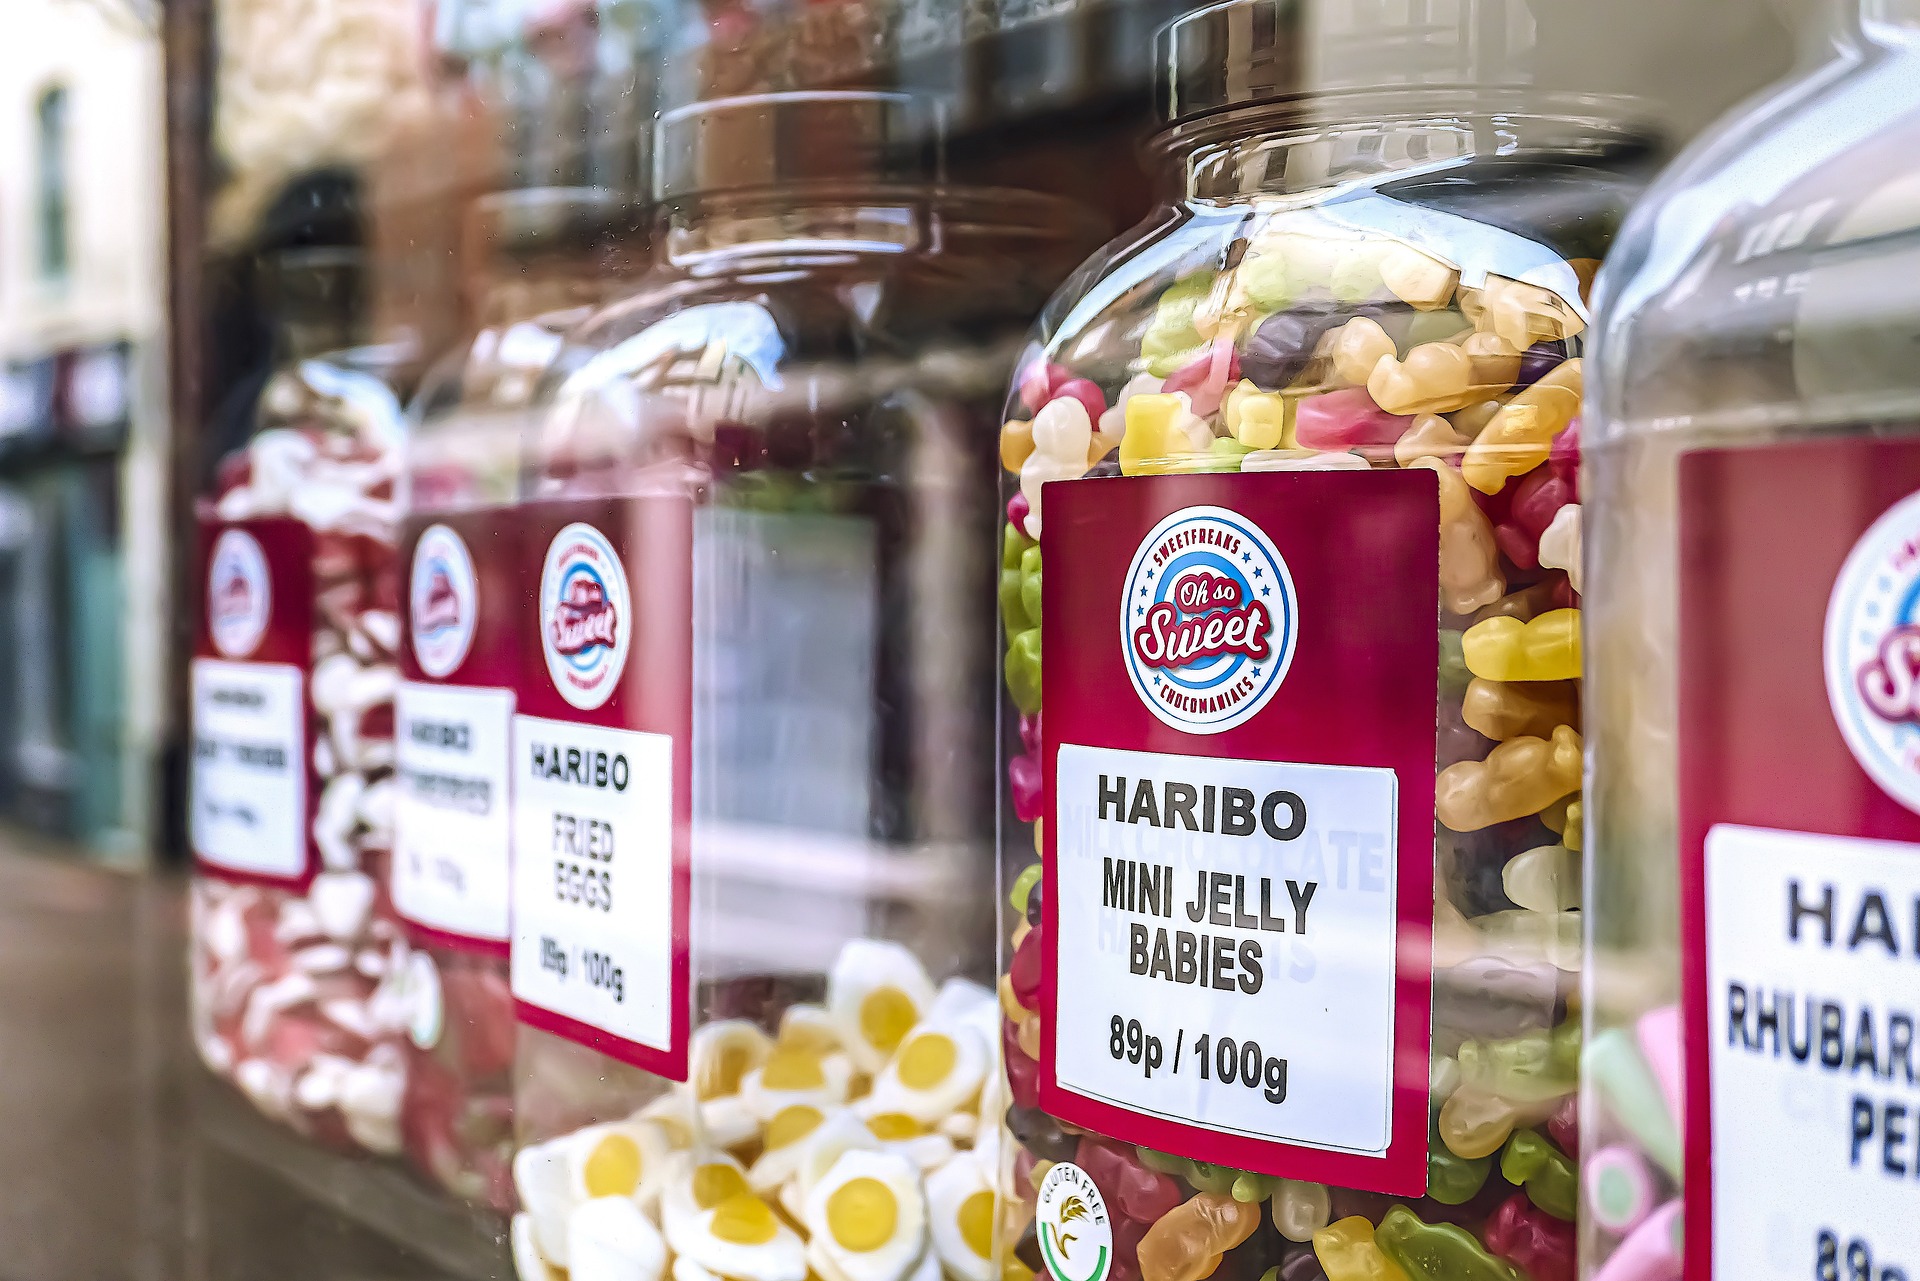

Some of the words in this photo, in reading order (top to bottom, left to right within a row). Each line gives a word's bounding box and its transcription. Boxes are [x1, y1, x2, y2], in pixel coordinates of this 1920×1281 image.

[1153, 528, 1241, 567] SWEETFREAKS
[1180, 582, 1209, 606] Oh
[1213, 584, 1235, 601] so
[1139, 607, 1263, 662] Sweet
[1160, 675, 1254, 715] CHOCOMANIACS
[531, 741, 629, 791] HARIBO
[1098, 774, 1306, 842] HARIBO
[553, 811, 613, 863] FRIED
[554, 861, 612, 912] EGGS
[1103, 857, 1173, 919] MINI
[1185, 870, 1318, 935] JELLY
[1789, 880, 1920, 959] HA
[1129, 923, 1263, 995] BABIES
[1109, 1015, 1163, 1079] 89p
[1172, 1028, 1184, 1074] /
[1194, 1033, 1288, 1104] 100g
[1851, 1097, 1920, 1178] PE
[1042, 1167, 1080, 1204] GLUTEN
[1080, 1179, 1106, 1226] FREE
[1816, 1228, 1906, 1281] 89
